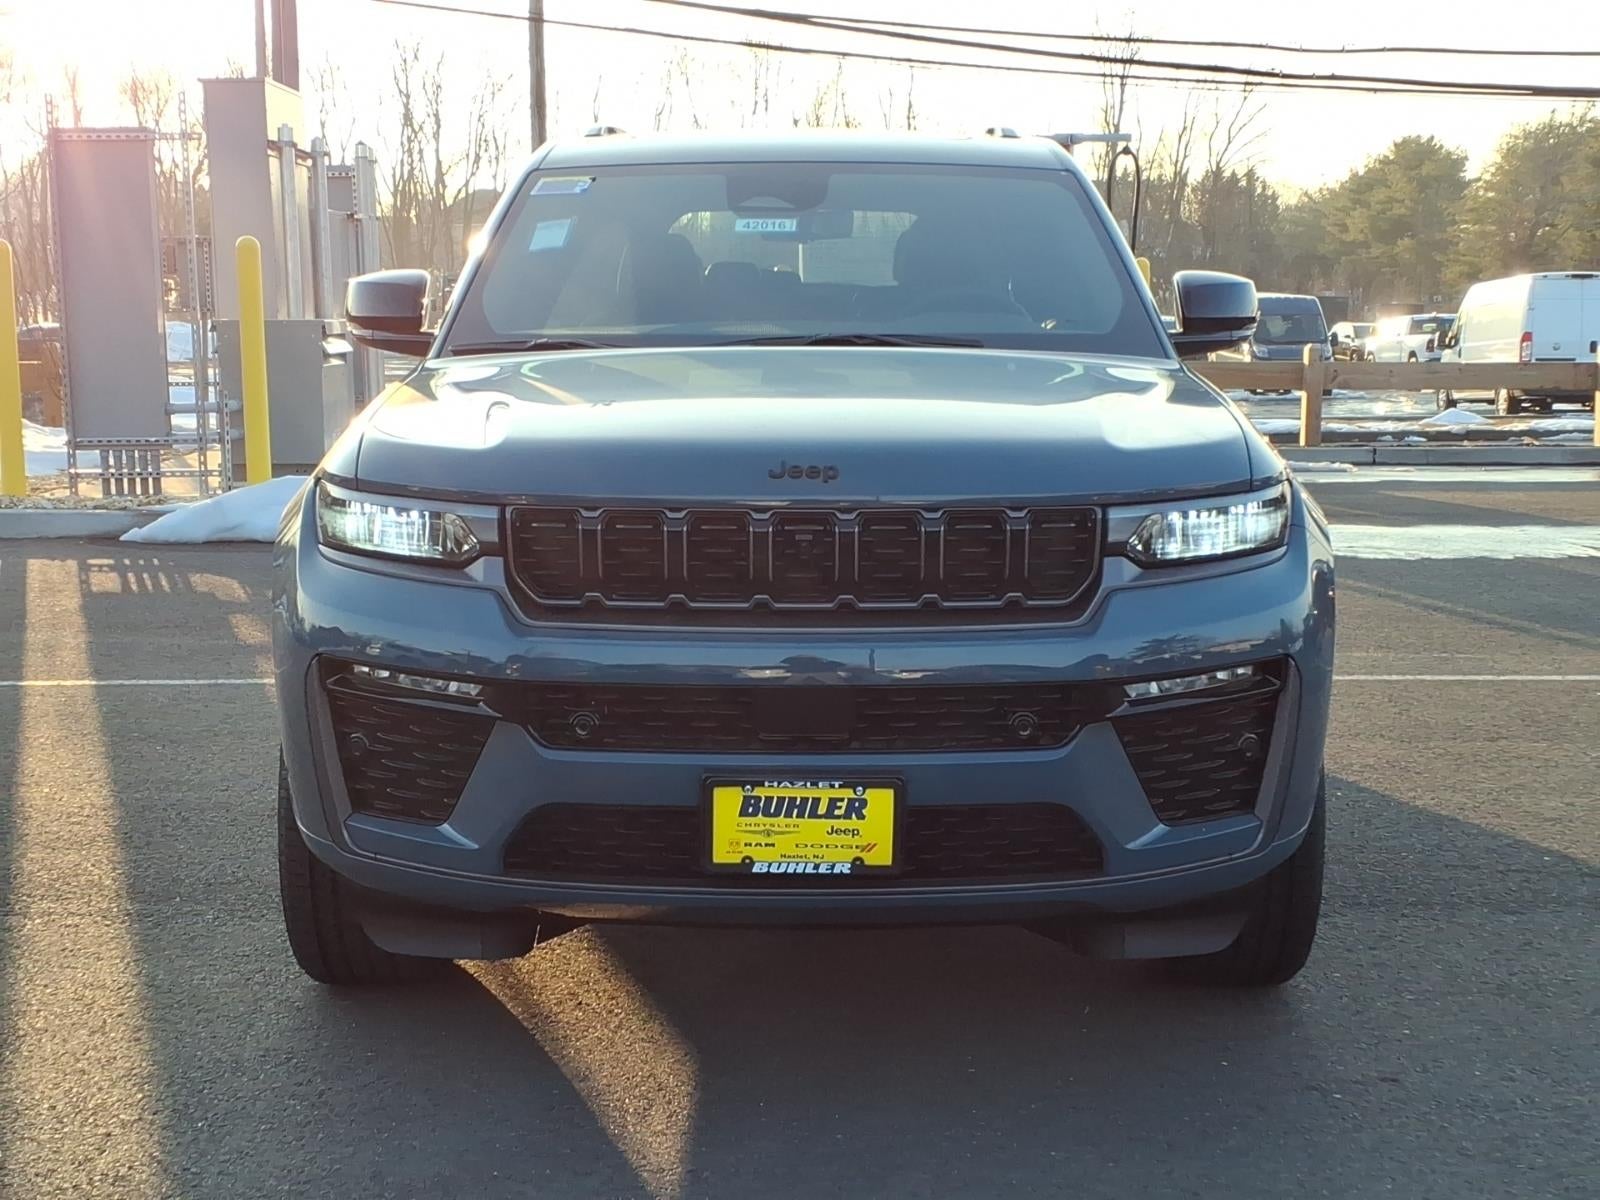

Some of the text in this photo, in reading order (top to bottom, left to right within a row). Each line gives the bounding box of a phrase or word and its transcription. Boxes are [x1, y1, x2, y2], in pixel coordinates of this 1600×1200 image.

[742, 220, 786, 230] 42016
[768, 460, 840, 483] Jeep
[738, 794, 868, 820] BUHLER
[826, 825, 860, 838] Jeep
[795, 843, 865, 851] DODGE
[752, 862, 852, 874] BUHLER
